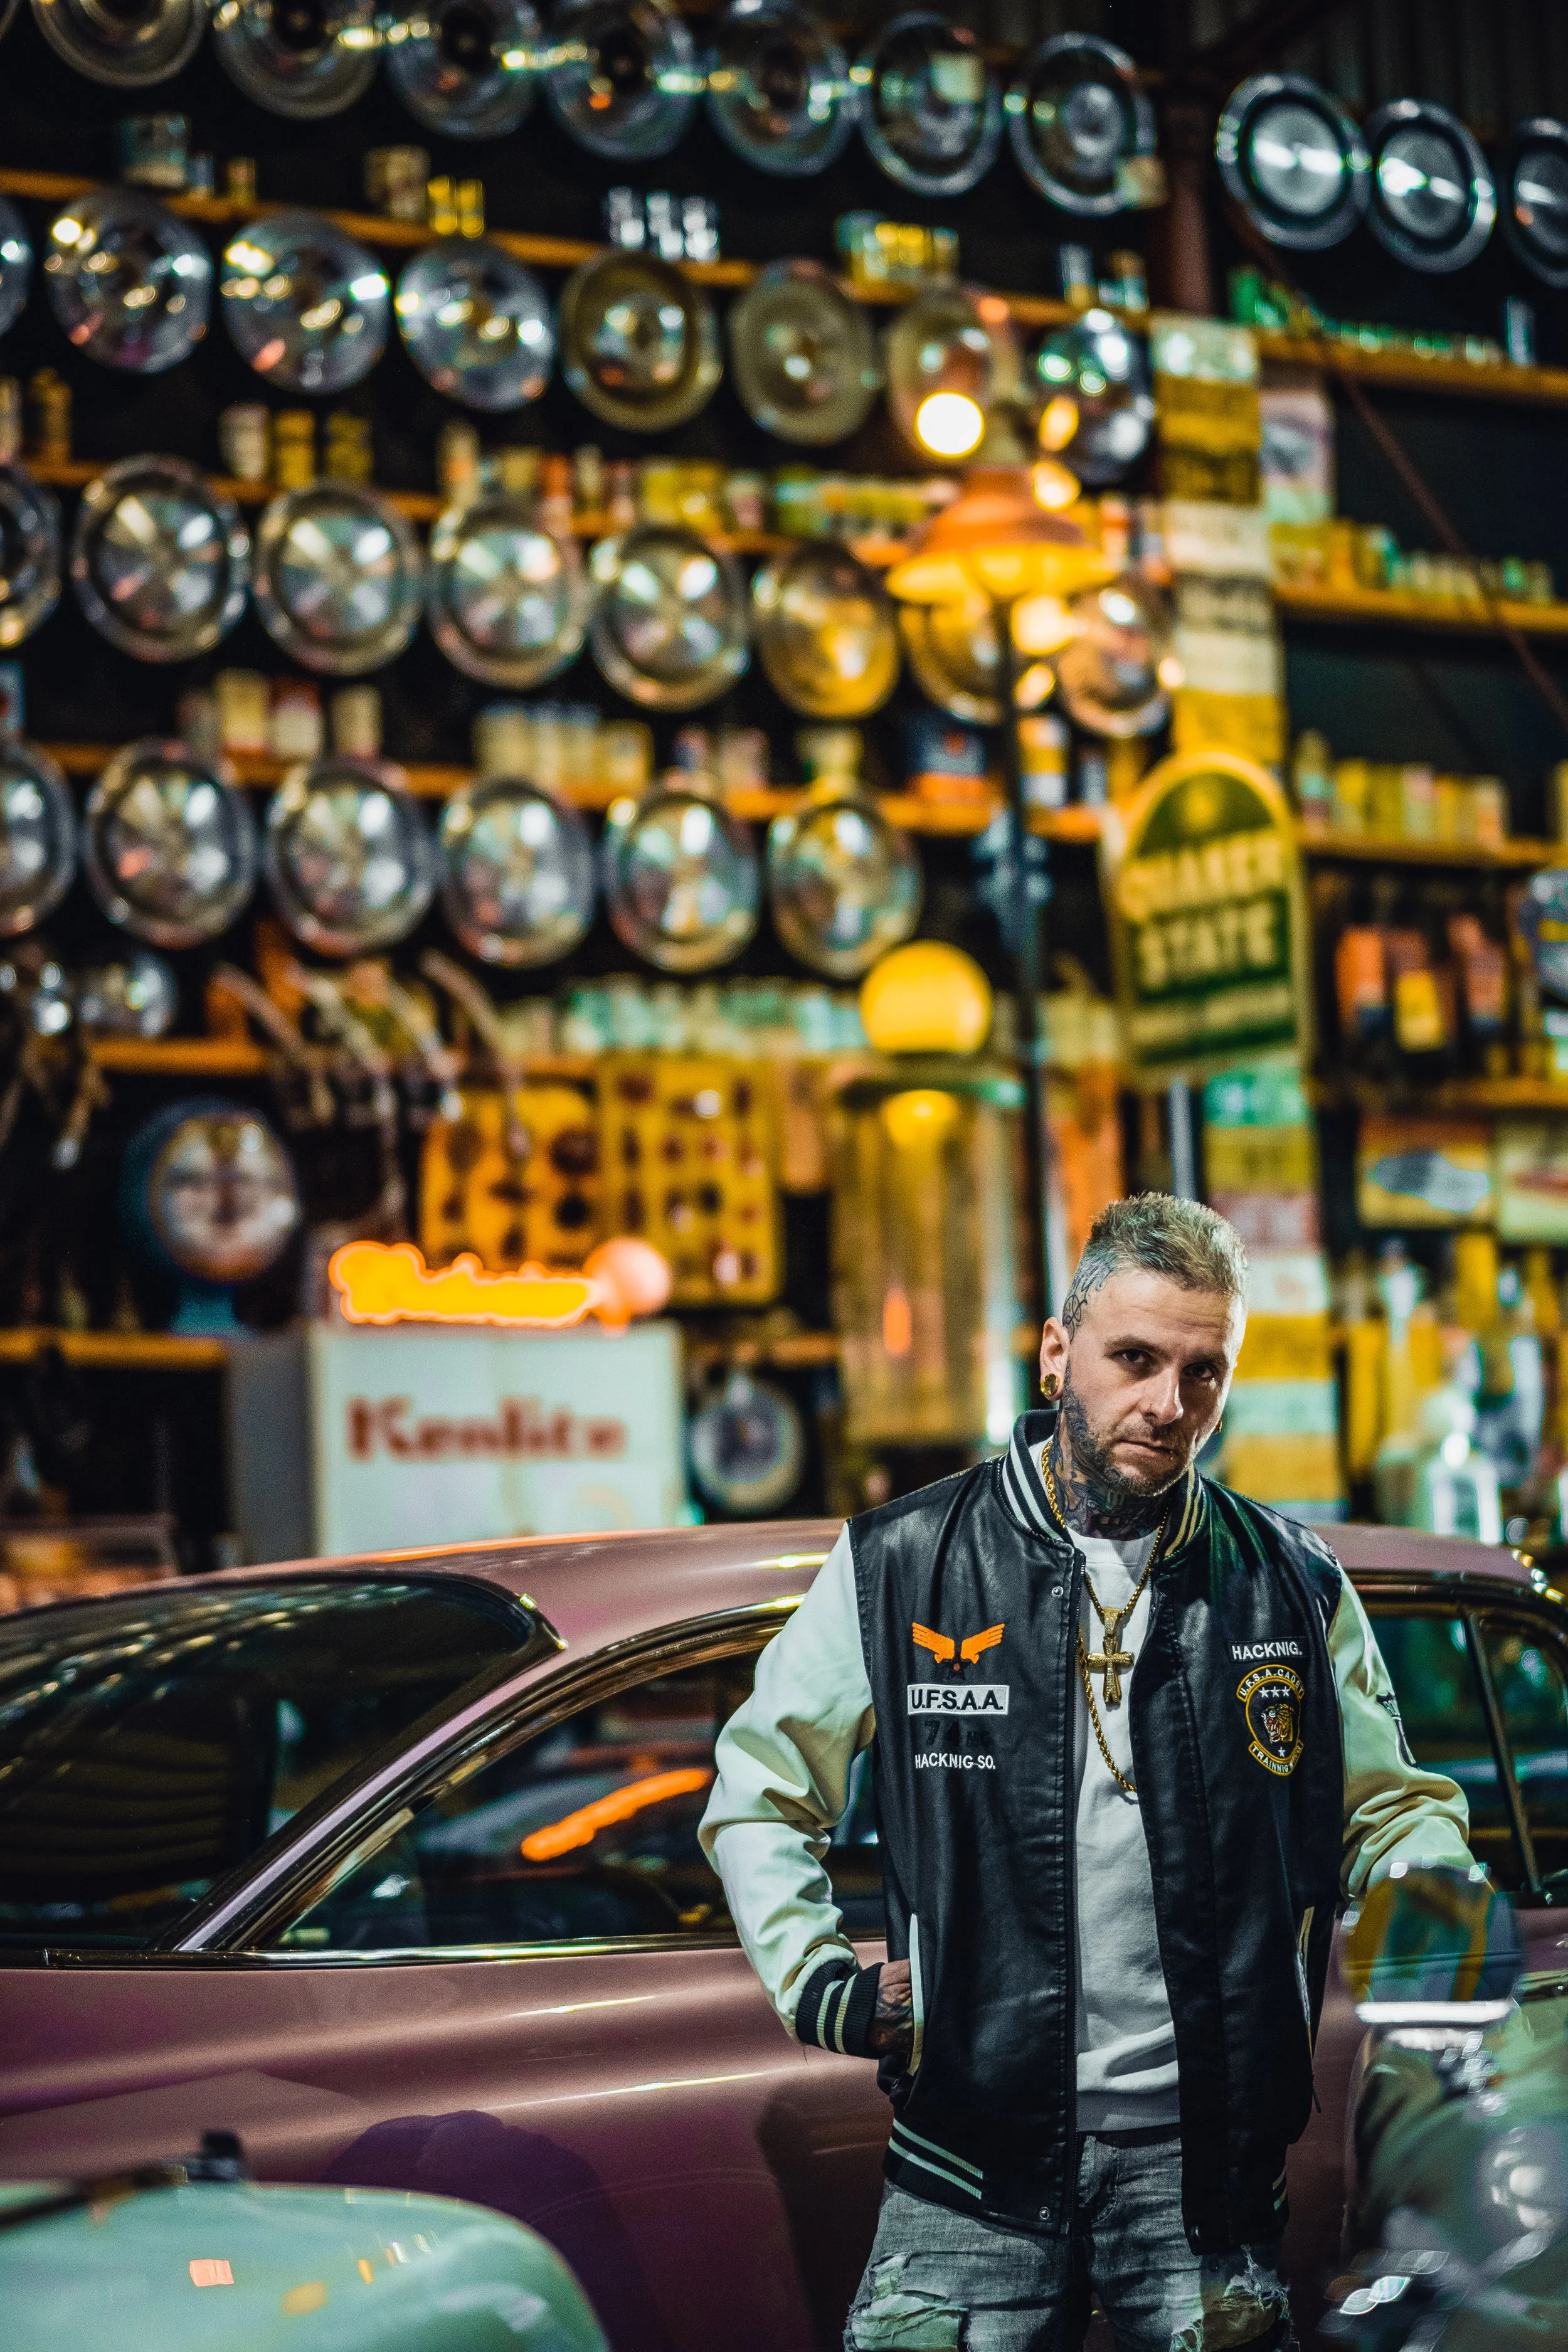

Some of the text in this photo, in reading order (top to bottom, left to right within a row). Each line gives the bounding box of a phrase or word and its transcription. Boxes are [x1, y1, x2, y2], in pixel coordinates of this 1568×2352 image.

[1138, 902, 1277, 990] STATE
[1231, 1641, 1303, 1660] HACKNIG.
[911, 1688, 1004, 1710] U.F.S.A.A.
[1252, 1744, 1288, 1772] TRAINNIG
